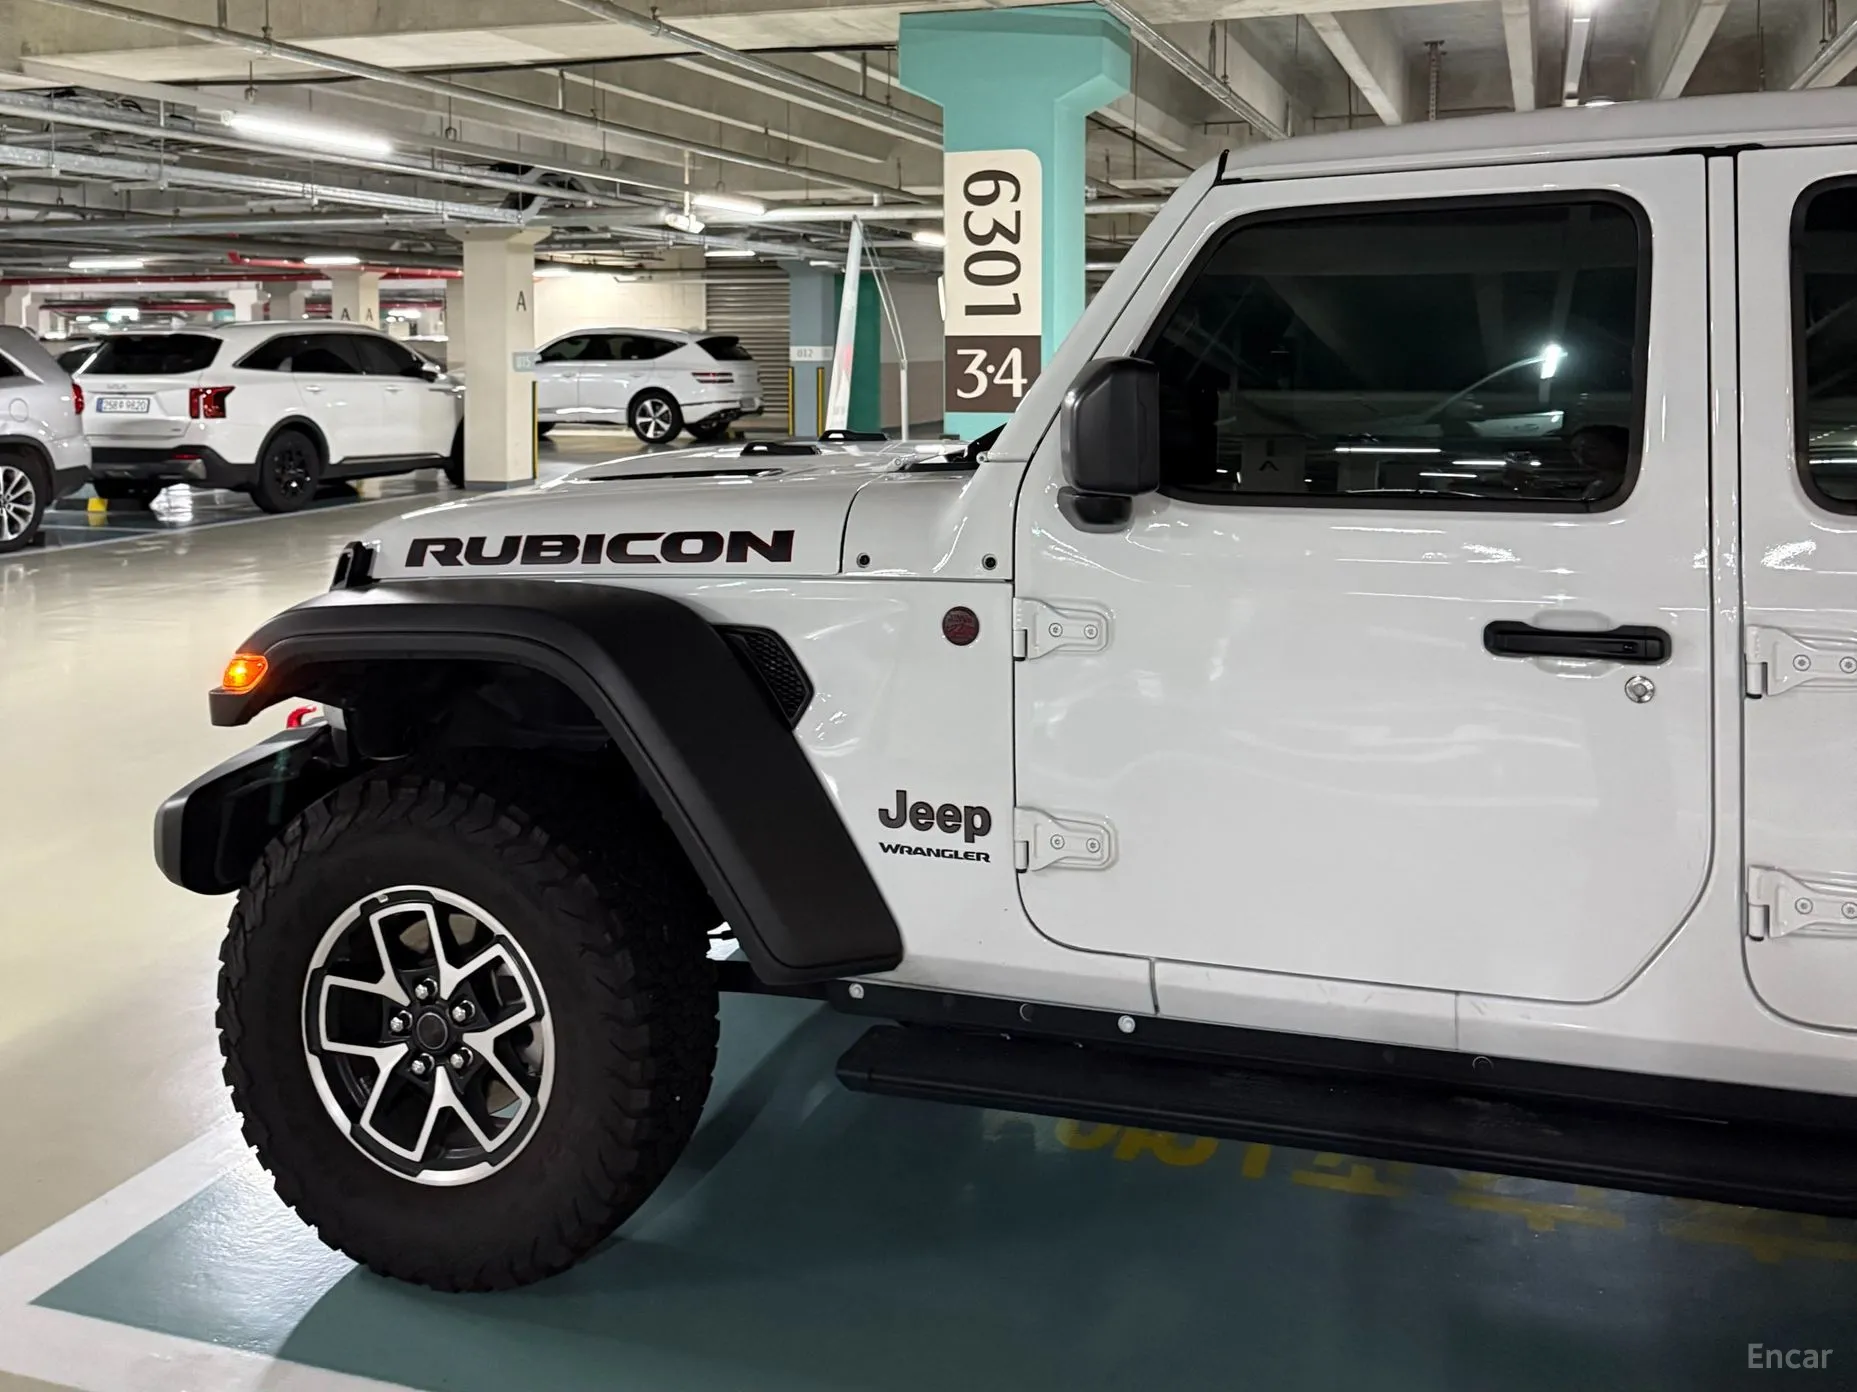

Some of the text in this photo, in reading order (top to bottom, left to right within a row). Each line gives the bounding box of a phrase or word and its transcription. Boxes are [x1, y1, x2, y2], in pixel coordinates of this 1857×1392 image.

[963, 169, 1021, 316] 6301
[515, 290, 527, 312] A
[340, 307, 351, 321] A
[365, 307, 374, 321] A
[404, 530, 795, 567] RUBICON
[878, 789, 992, 843] Jeep
[878, 841, 991, 863] WRANGLER
